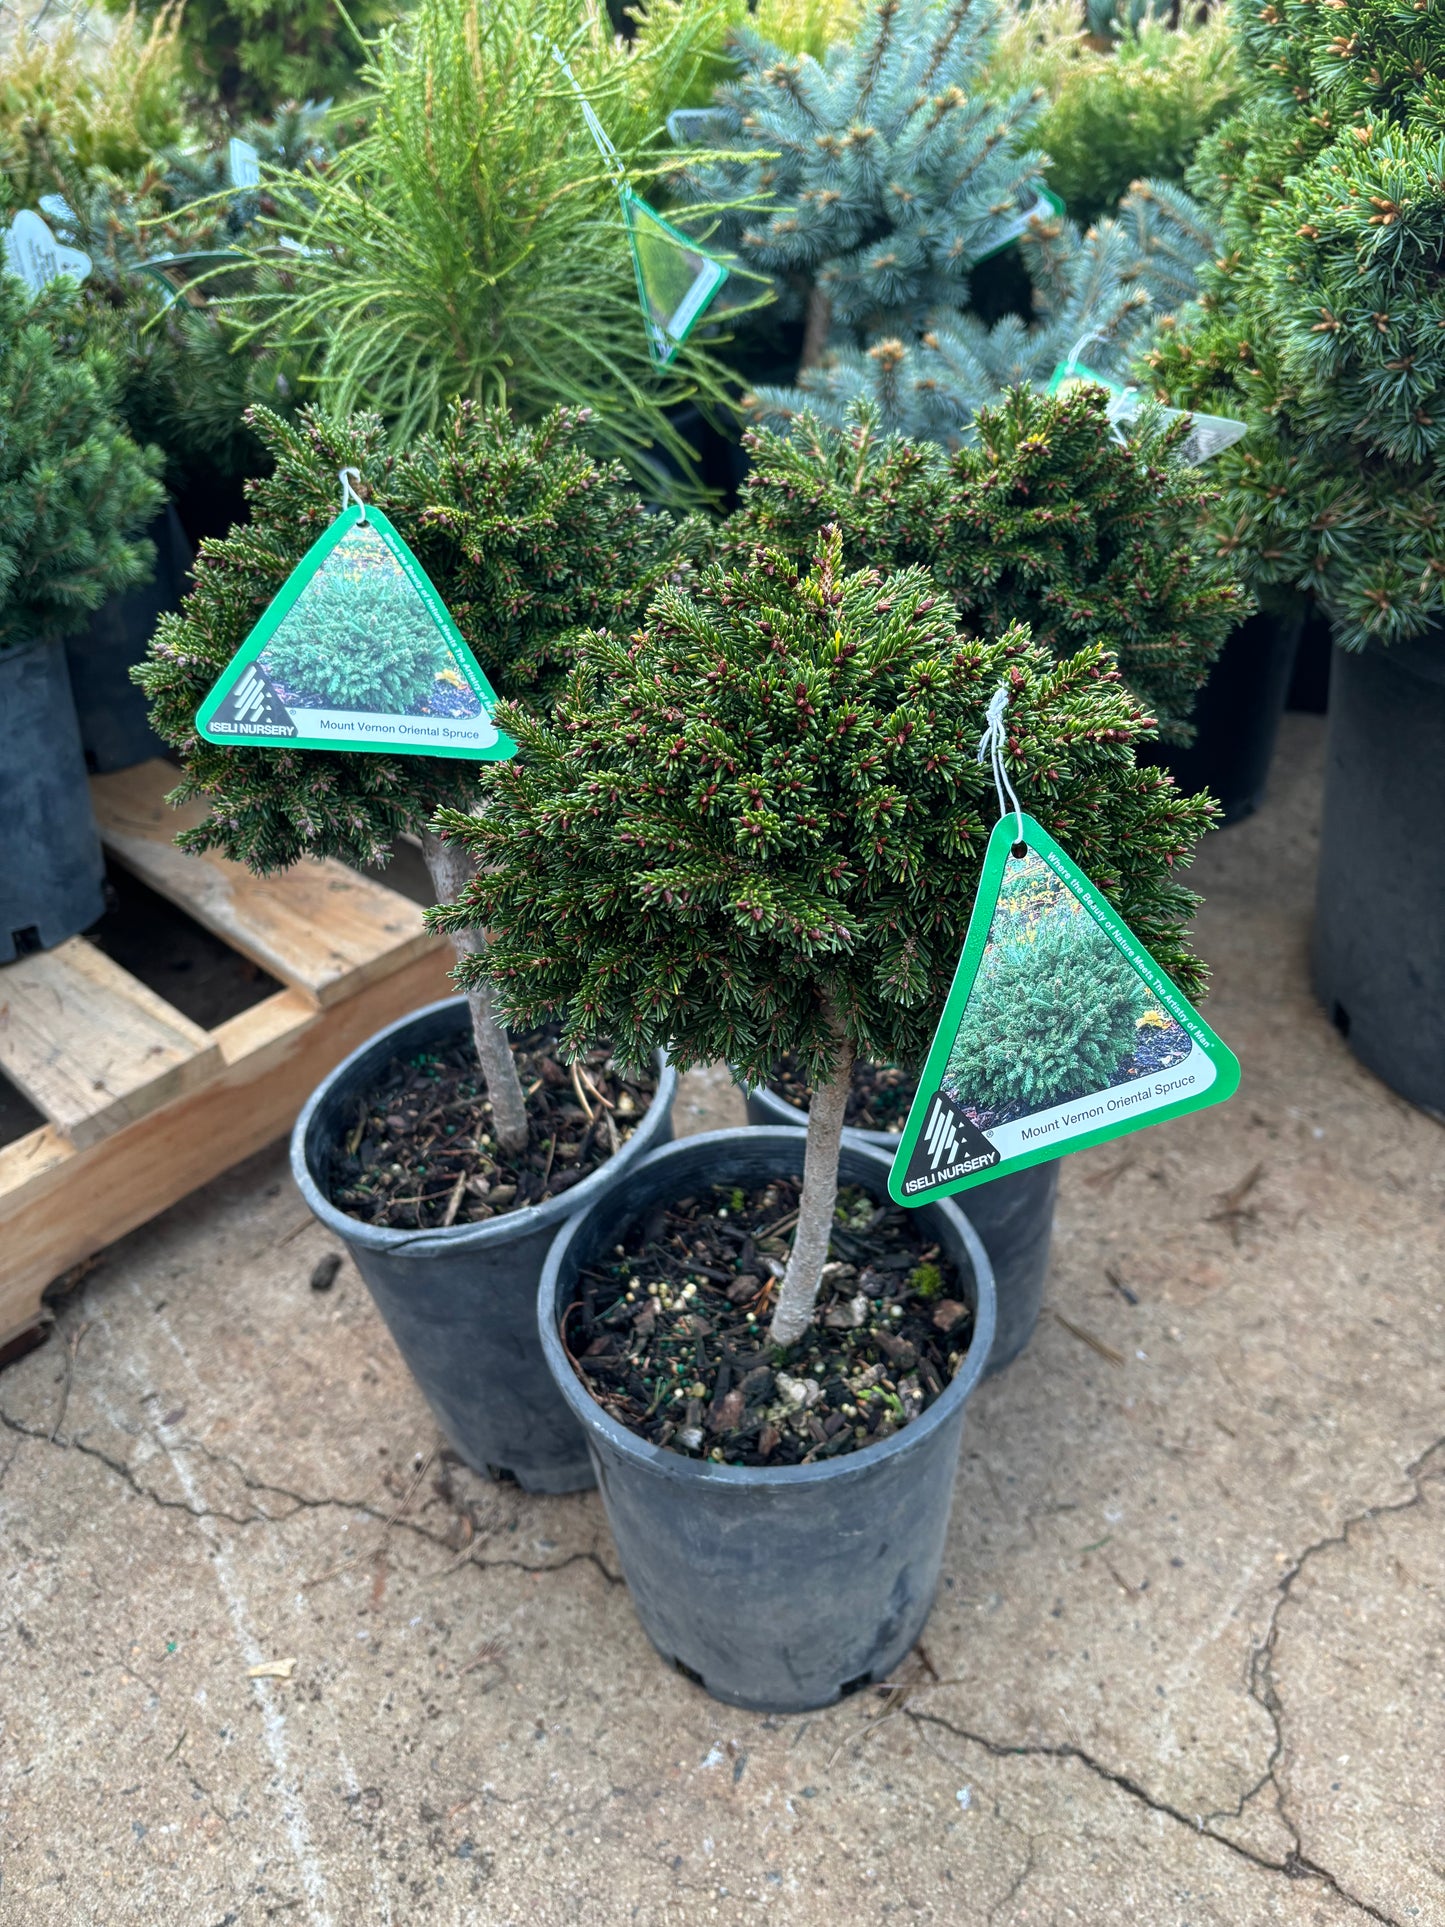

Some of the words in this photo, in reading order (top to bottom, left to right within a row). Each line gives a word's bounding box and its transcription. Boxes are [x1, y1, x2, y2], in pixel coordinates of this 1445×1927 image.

[397, 553, 408, 565] the
[405, 565, 424, 589] Beauty
[420, 589, 431, 598] of
[426, 598, 444, 624] Nature
[441, 624, 458, 648] Meets
[455, 648, 466, 663] The
[463, 663, 482, 692] Artistry
[479, 691, 489, 701] of
[209, 722, 238, 733] ISELI
[240, 723, 295, 736] NURSERY
[320, 719, 355, 731] Mount
[357, 722, 396, 733] Vernon
[399, 724, 440, 736] Oriental
[442, 728, 479, 740] Spruce
[1047, 852, 1071, 879] Where
[1070, 879, 1084, 894] the
[1082, 893, 1107, 922] Beauty
[1105, 921, 1116, 931] of
[1112, 929, 1135, 957] Nature
[1132, 956, 1154, 981] Meets
[1152, 979, 1166, 995] The
[1163, 995, 1189, 1023] Artistry
[1187, 1022, 1199, 1031] of
[1021, 1119, 1060, 1141] Mount
[1061, 1105, 1104, 1127] Vernon
[1106, 1087, 1152, 1112] Oriental
[1155, 1075, 1196, 1095] Spruce
[905, 1173, 936, 1194] ISELI
[937, 1151, 996, 1182] NURSERY
